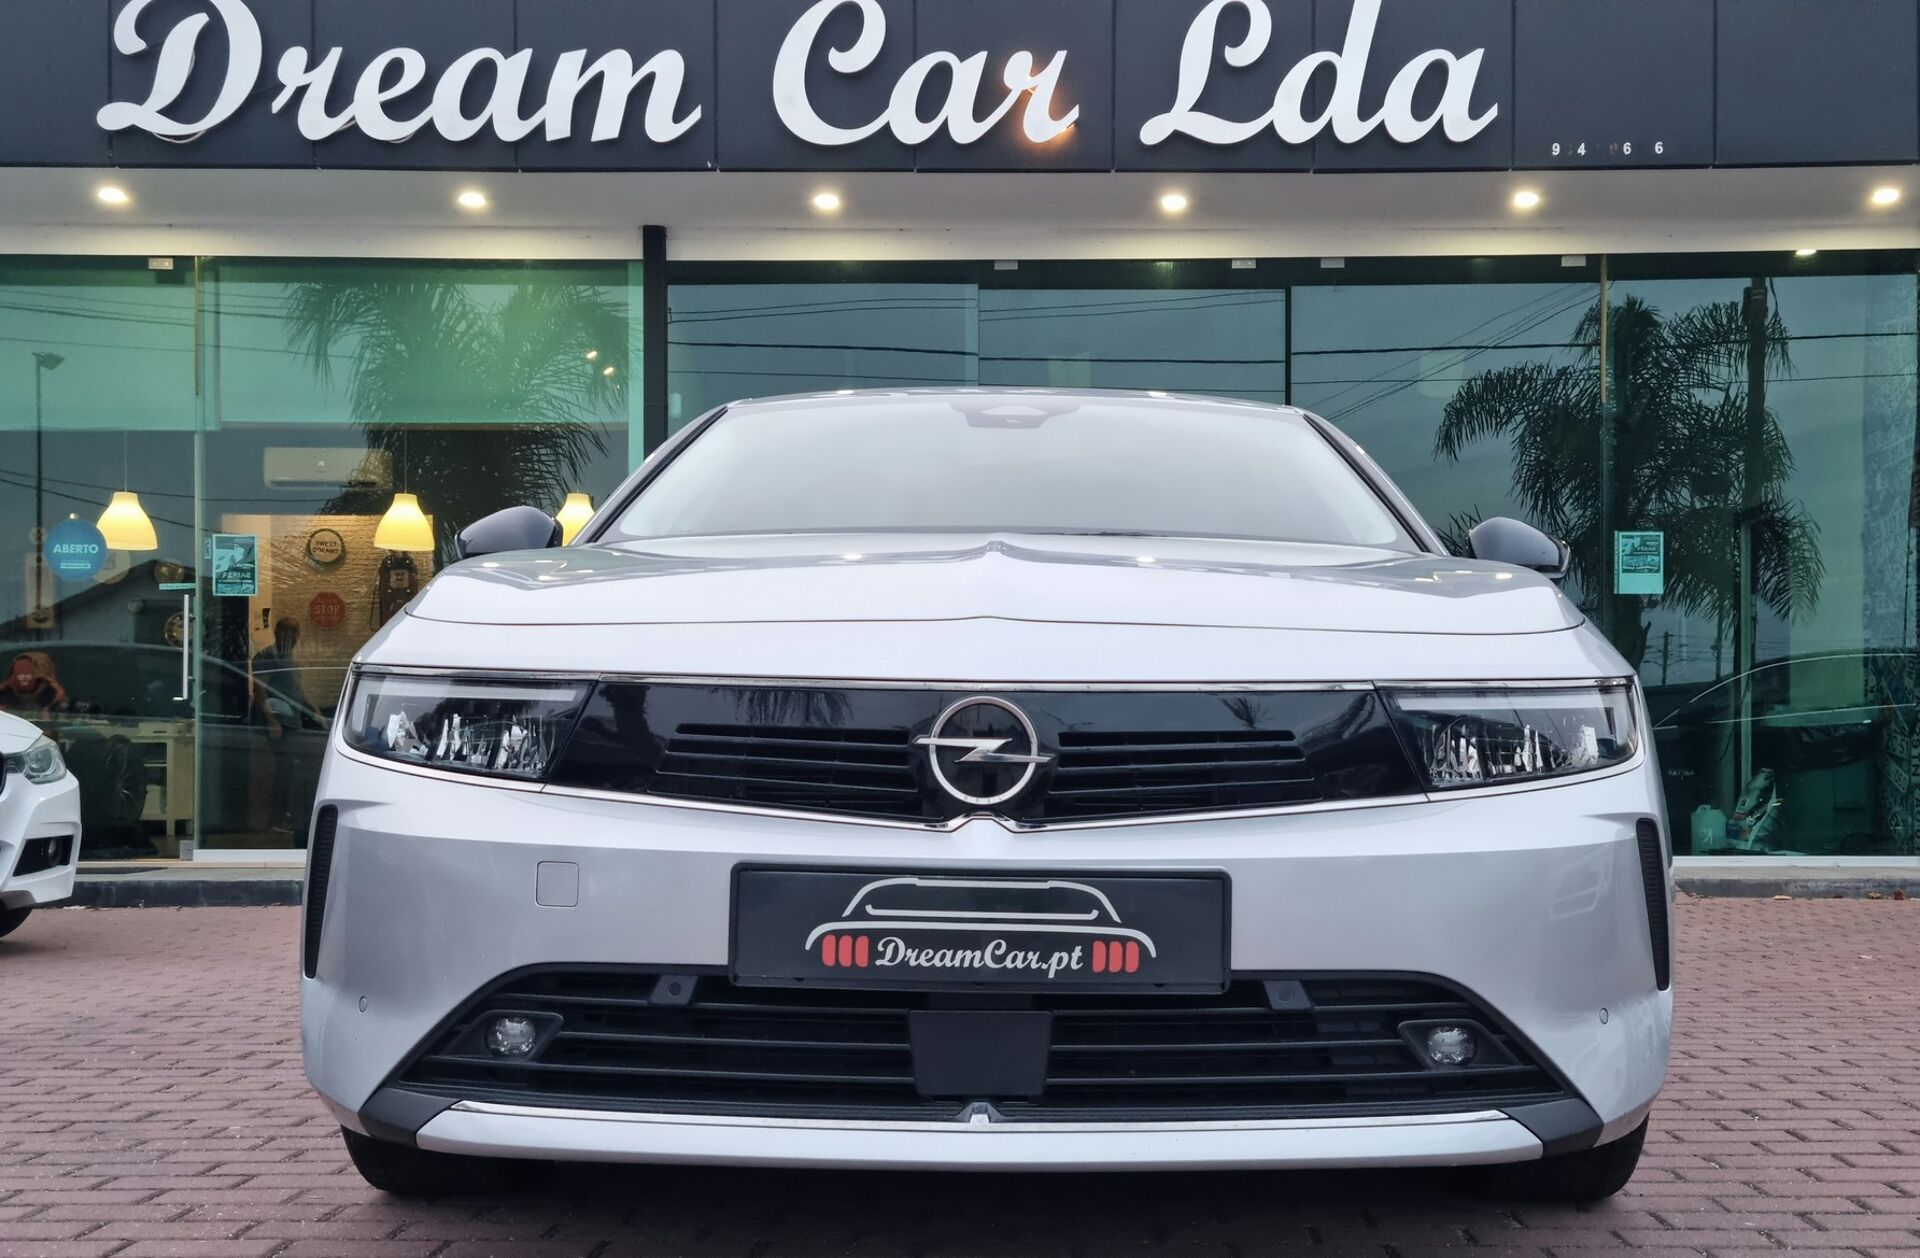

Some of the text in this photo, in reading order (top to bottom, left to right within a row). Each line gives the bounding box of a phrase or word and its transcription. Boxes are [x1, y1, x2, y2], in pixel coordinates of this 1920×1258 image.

[97, 0, 1498, 145] Dream Car Lda
[53, 543, 99, 554] ABERTO
[314, 604, 340, 615] STOP
[875, 936, 1084, 979] DreamCar.pt
